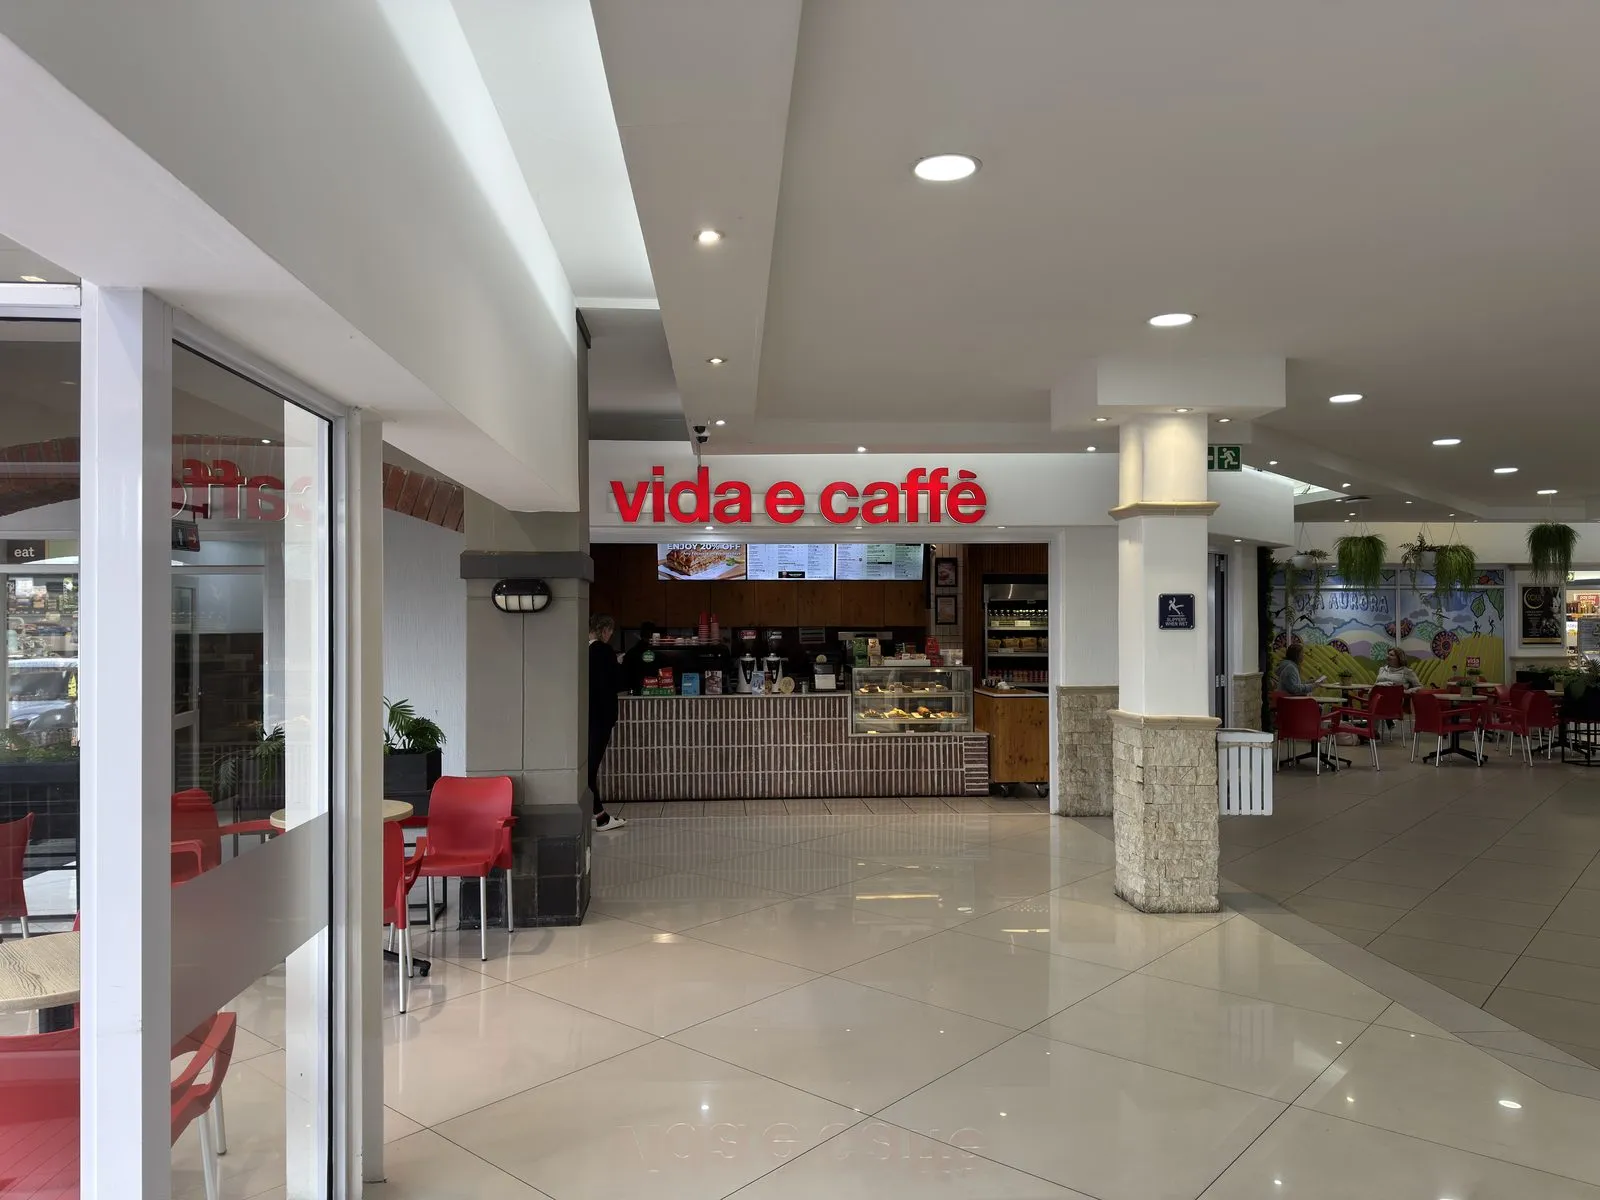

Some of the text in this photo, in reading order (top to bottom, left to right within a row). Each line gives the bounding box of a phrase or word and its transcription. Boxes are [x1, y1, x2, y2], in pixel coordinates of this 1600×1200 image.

[610, 465, 987, 524] vida e caffè
[14, 547, 35, 558] eat
[1329, 592, 1389, 613] AURORA
